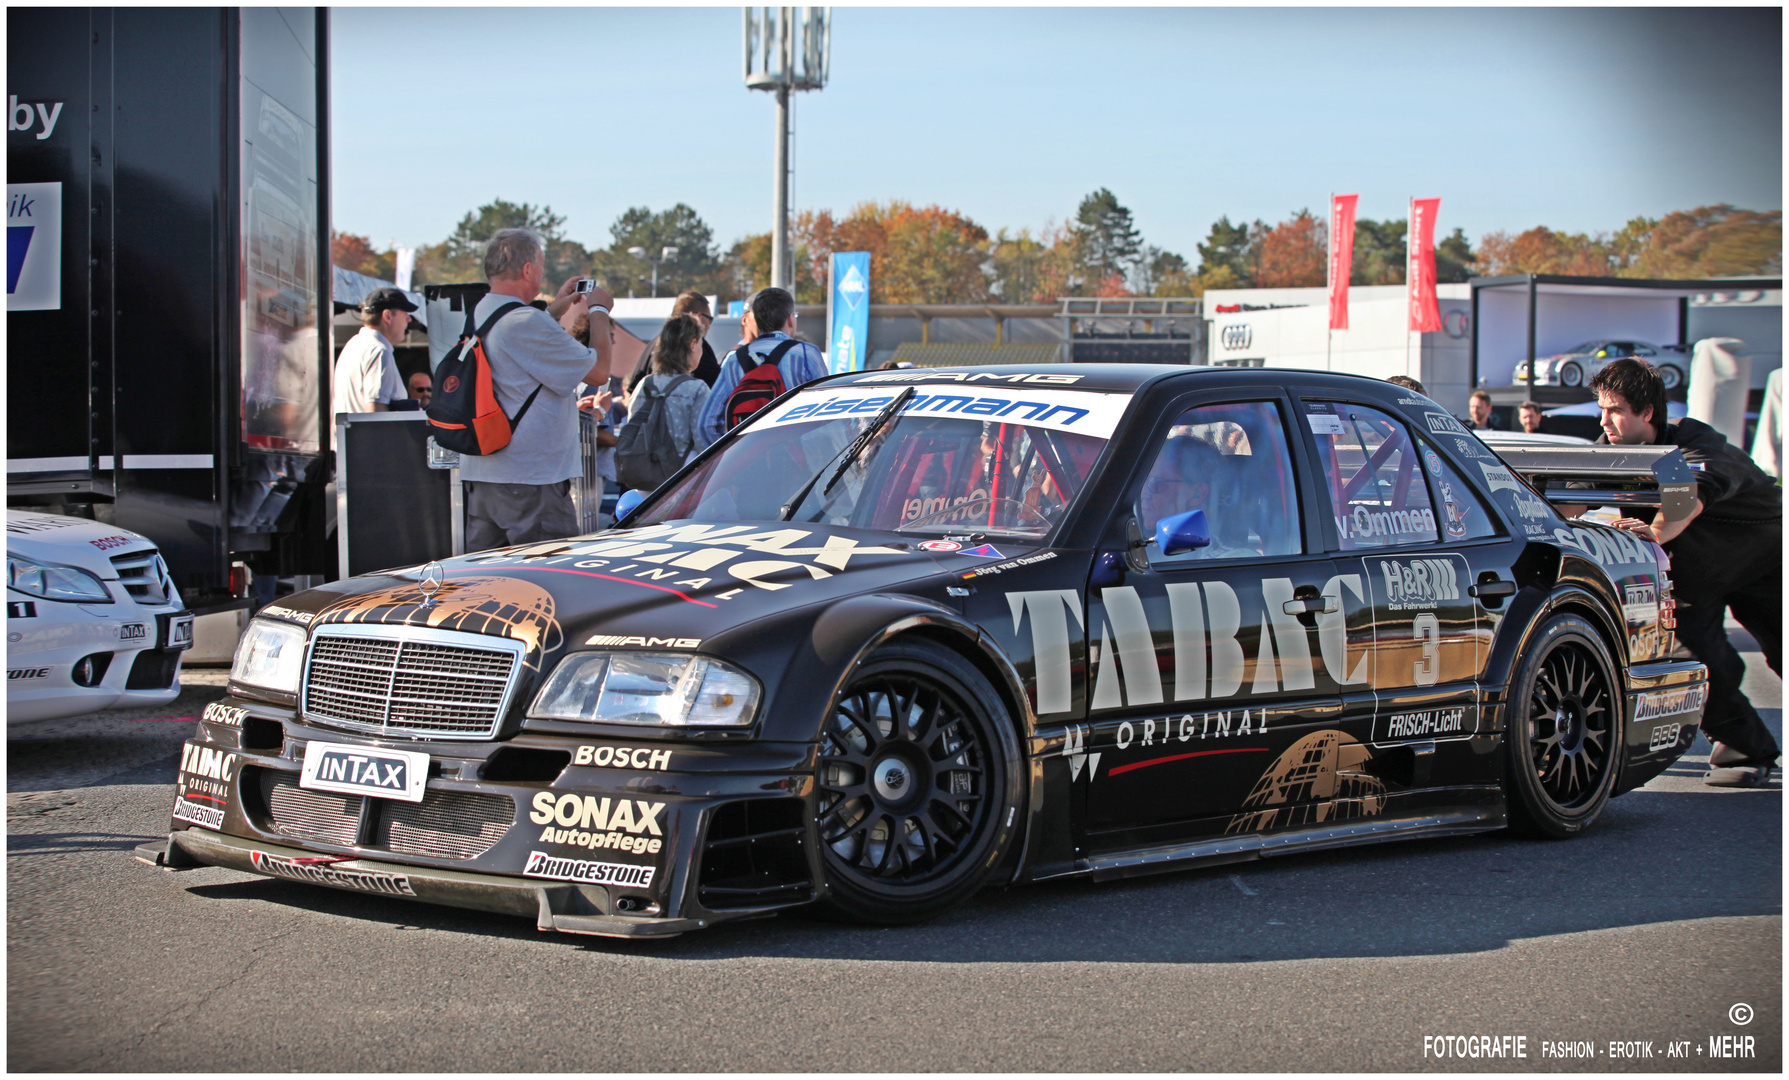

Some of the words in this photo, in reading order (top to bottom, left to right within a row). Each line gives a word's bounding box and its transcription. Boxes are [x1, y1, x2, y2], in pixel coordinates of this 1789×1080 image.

[8, 94, 64, 140] by
[6, 194, 35, 218] ik
[922, 373, 1086, 385] AMG
[776, 393, 1090, 426] eisenmann
[1428, 416, 1467, 434] INTAX
[1354, 505, 1437, 538] Ommen
[1522, 523, 1546, 535] RACING
[89, 535, 132, 551] BOSCH
[1554, 527, 1657, 565] SONAX
[478, 556, 744, 600] ORIGINAL
[975, 566, 1001, 577] Jörg
[999, 561, 1019, 571] van
[1016, 551, 1058, 566] Ommen
[1381, 559, 1437, 601] H&R
[14, 602, 27, 617] 1
[274, 608, 316, 624] AMG
[1389, 602, 1402, 611] Das
[121, 624, 145, 639] INTAX
[617, 635, 702, 648] AMG
[1005, 573, 1369, 715] TABAC
[1413, 612, 1440, 688] 3
[203, 702, 250, 726] BOSCH
[1635, 688, 1705, 720] BRIDGESTONE
[1116, 708, 1268, 749] ORIGINAL
[1388, 708, 1463, 738] FRISCH-Licht
[1651, 723, 1679, 749] BBS
[180, 743, 237, 782] TABAC
[321, 755, 405, 789] INTAX
[574, 744, 673, 771] BOSCH
[189, 777, 229, 798] ORIGINAL
[174, 799, 223, 828] BRIDGESTONE
[529, 790, 666, 836] SONAX
[539, 825, 663, 855] Autopflege
[252, 851, 412, 896] BRIDGESTONE
[530, 851, 652, 886] BRIDGESTONE
